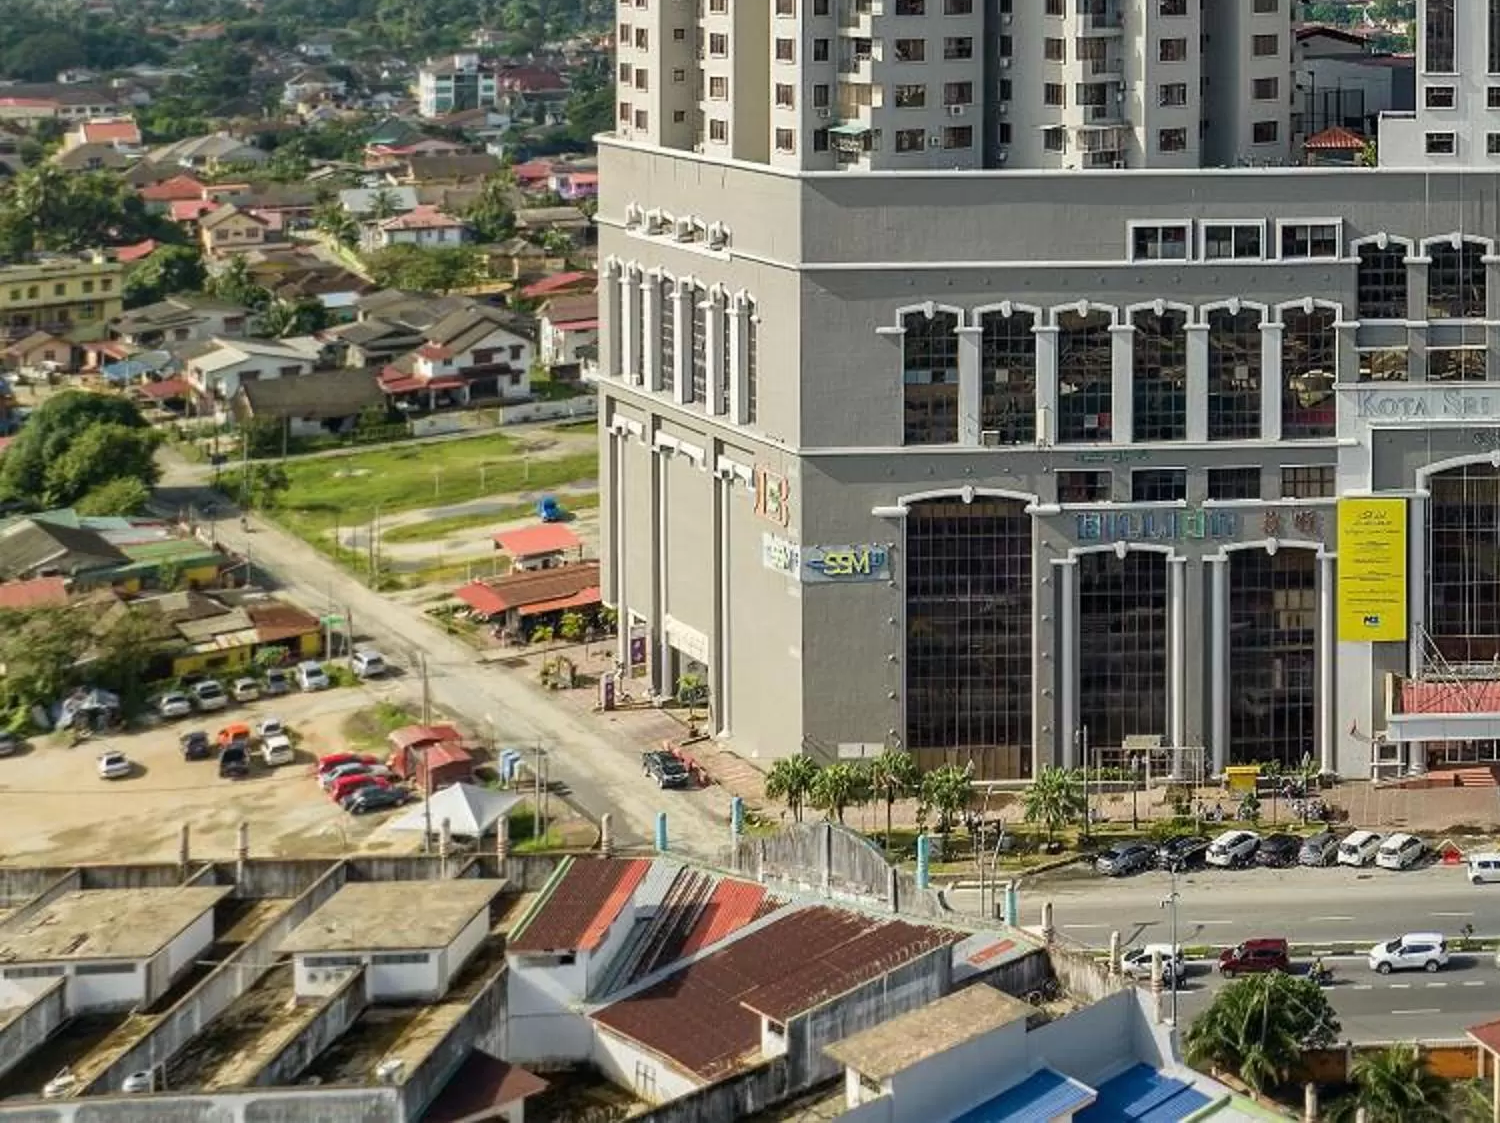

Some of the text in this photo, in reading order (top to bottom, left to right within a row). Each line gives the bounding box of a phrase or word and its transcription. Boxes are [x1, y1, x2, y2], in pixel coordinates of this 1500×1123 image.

[1357, 389, 1429, 417] KOTA
[1443, 389, 1490, 417] SRI
[823, 547, 872, 575] SSM
